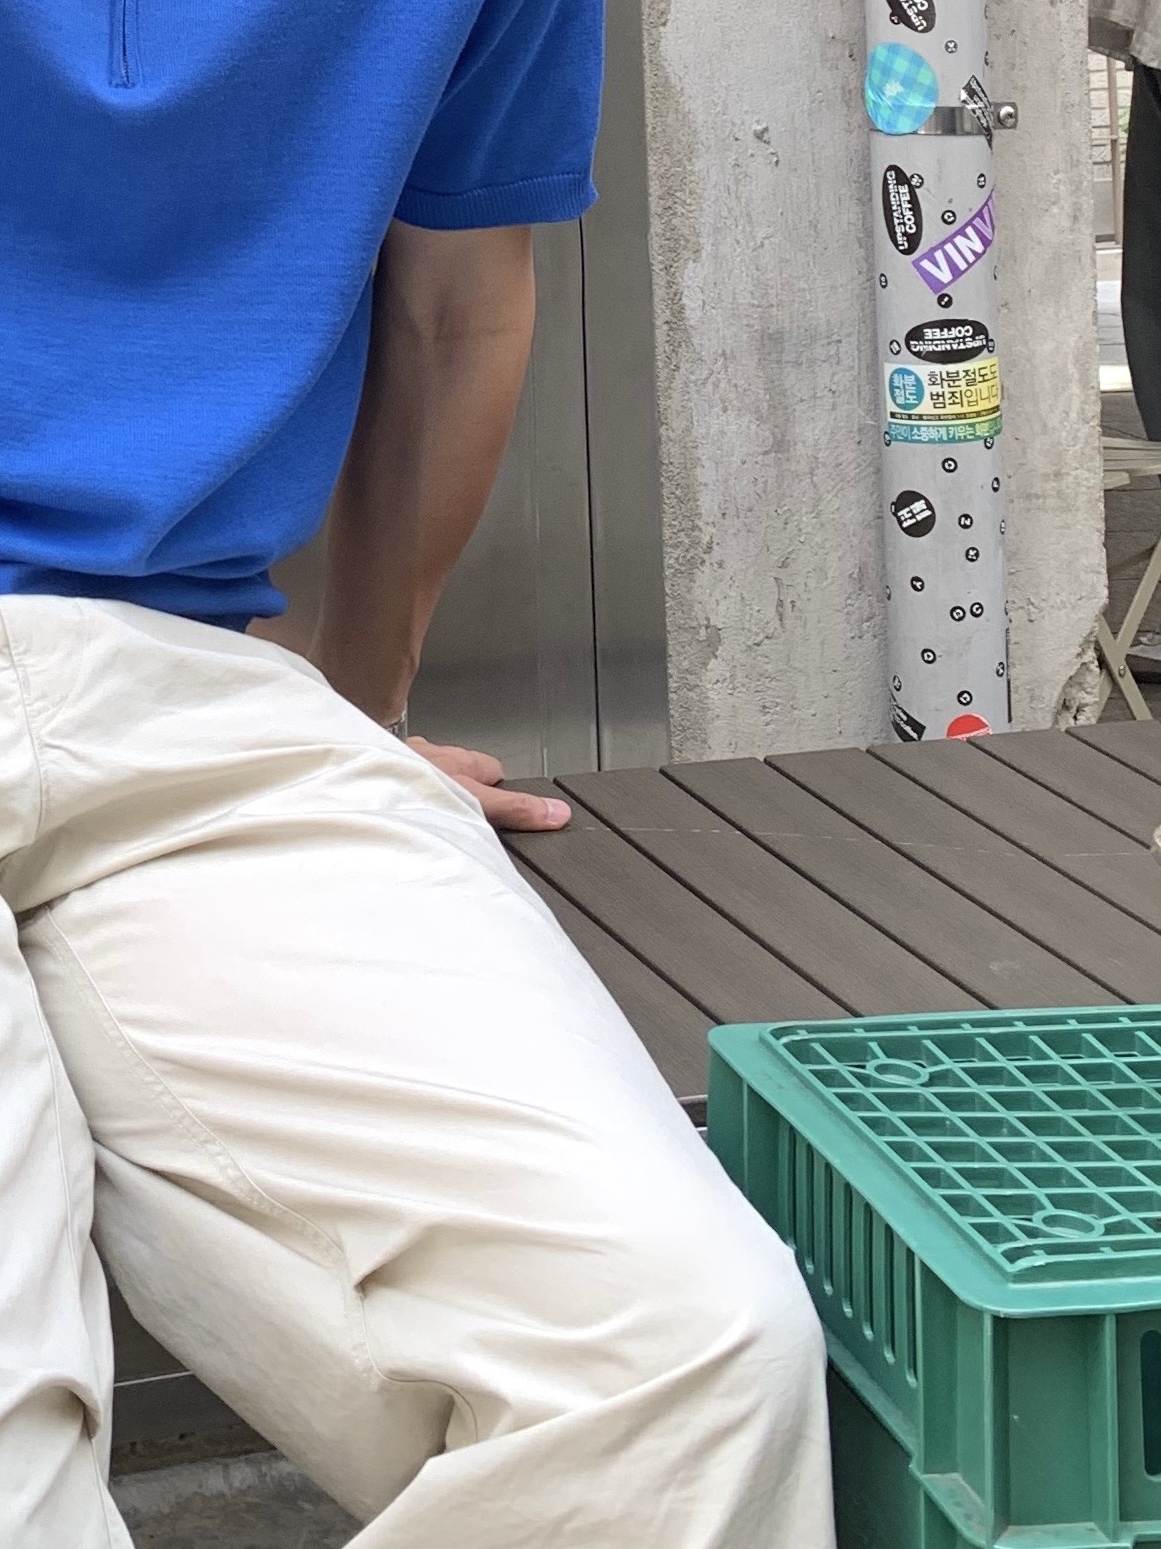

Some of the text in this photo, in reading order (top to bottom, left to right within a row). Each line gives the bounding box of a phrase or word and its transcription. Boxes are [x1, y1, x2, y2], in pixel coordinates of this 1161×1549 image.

[886, 170, 908, 250] UPSTANDING
[899, 183, 916, 234] COFFEE
[910, 334, 987, 352] UPSTANDING
[923, 325, 973, 340] COFFEE
